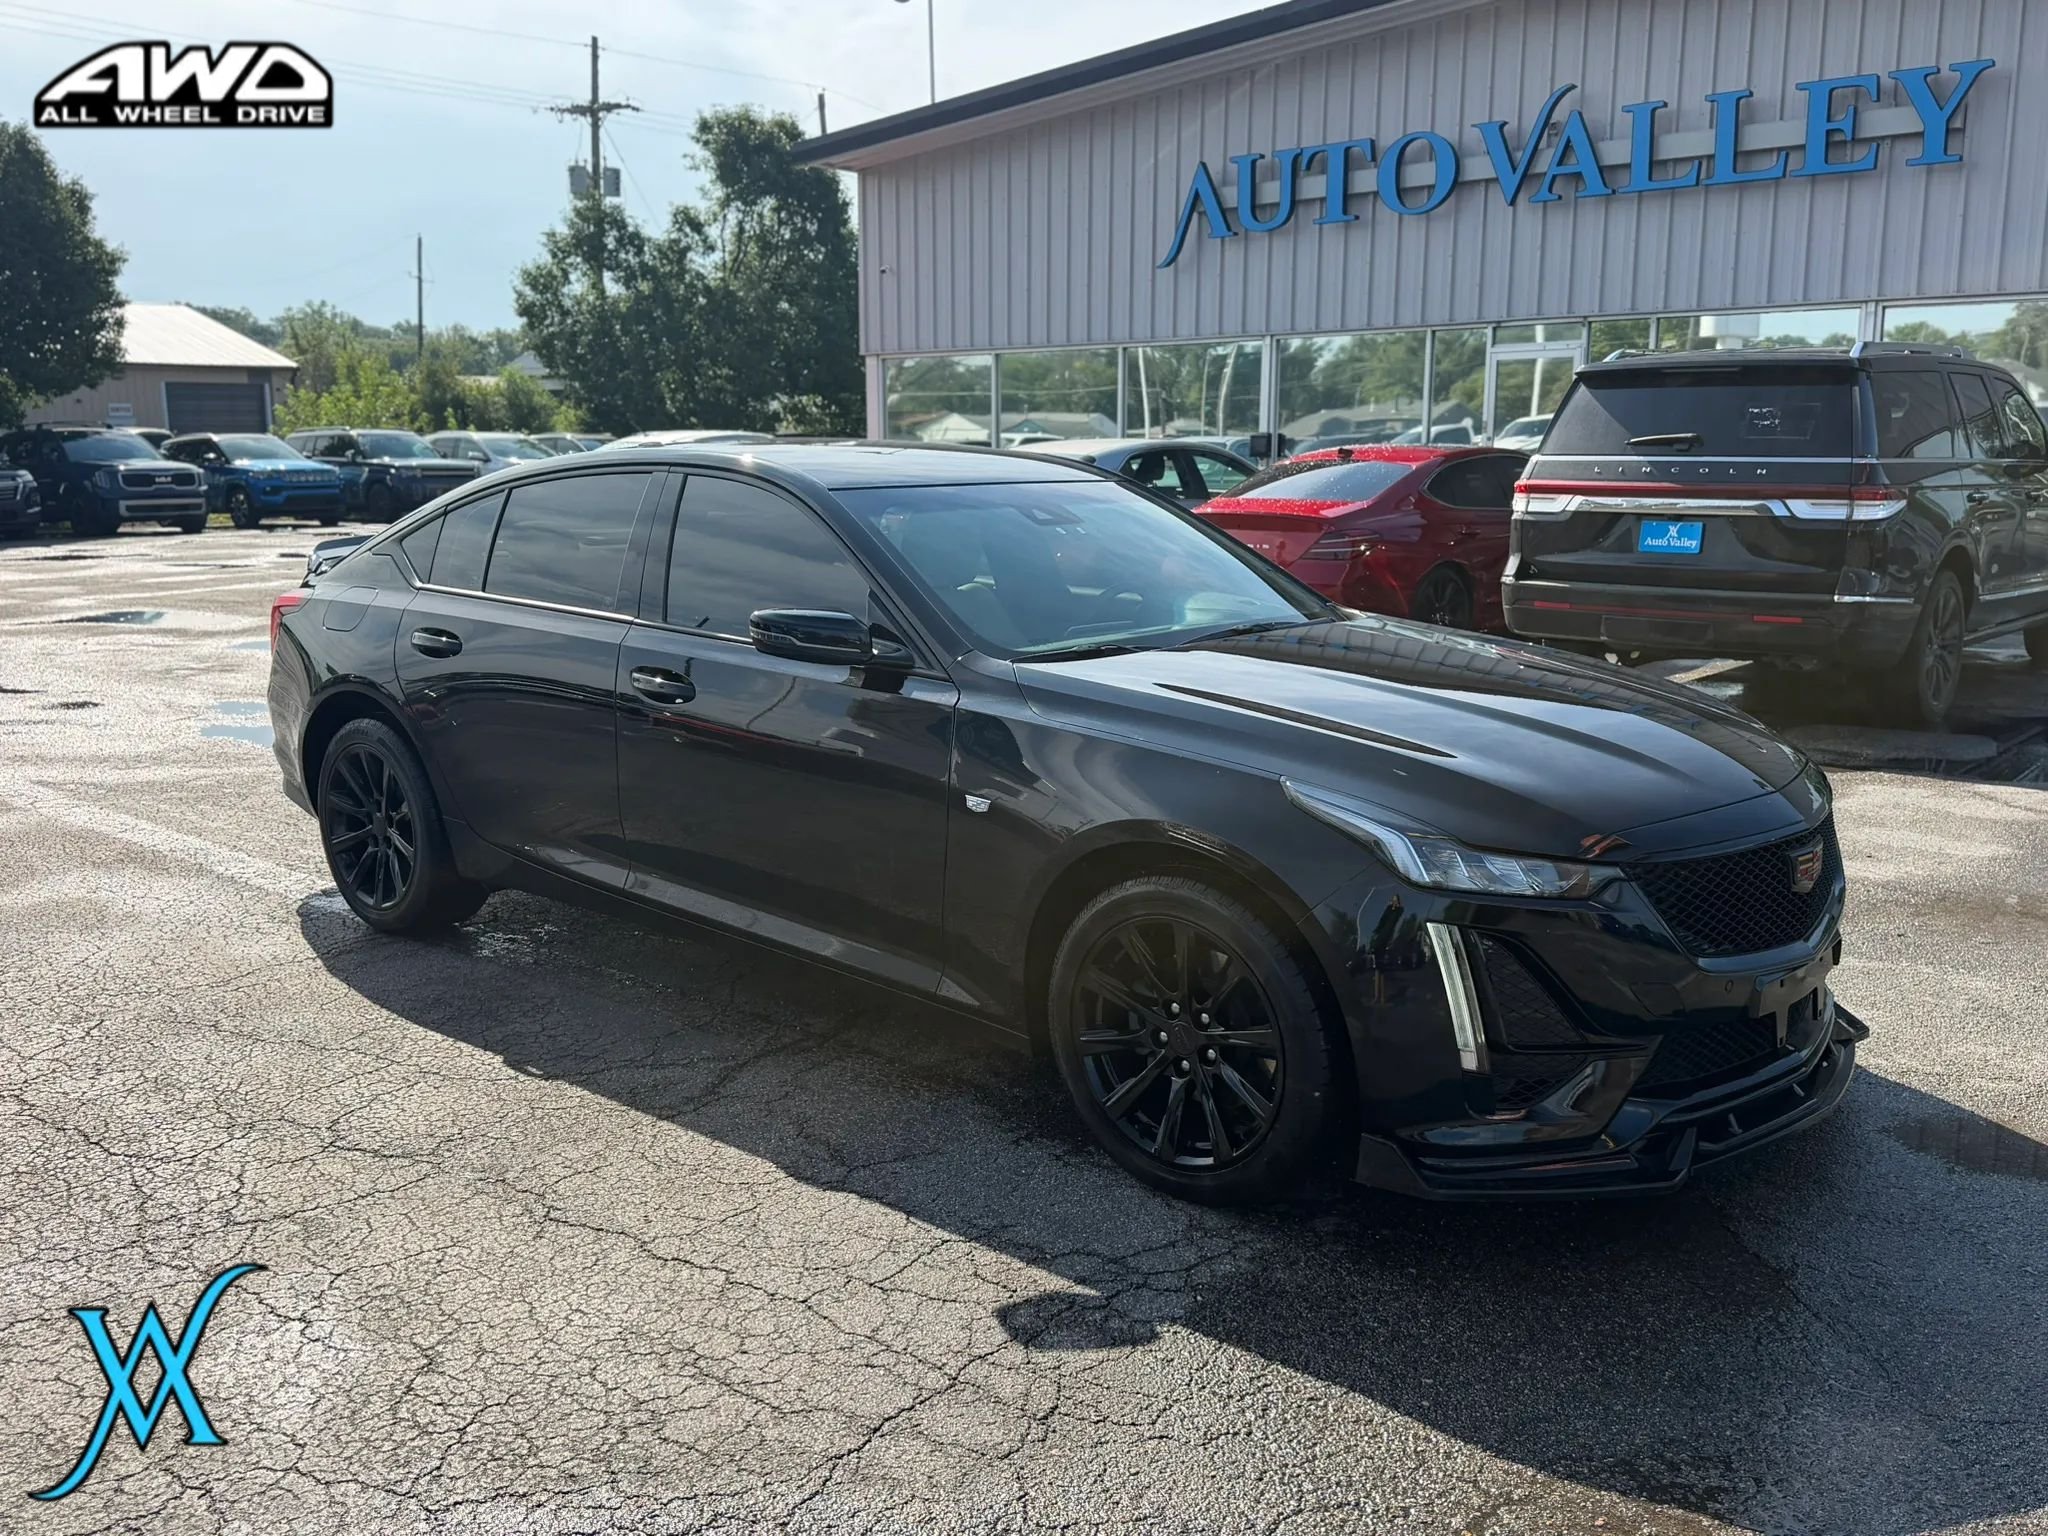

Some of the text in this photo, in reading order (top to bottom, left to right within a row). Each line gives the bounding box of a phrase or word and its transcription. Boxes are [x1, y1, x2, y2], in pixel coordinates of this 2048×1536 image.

[1156, 58, 1996, 269] AUTO VALLEY
[1594, 465, 1767, 475] LINCOLN
[1644, 537, 1697, 549] Auto Valley
